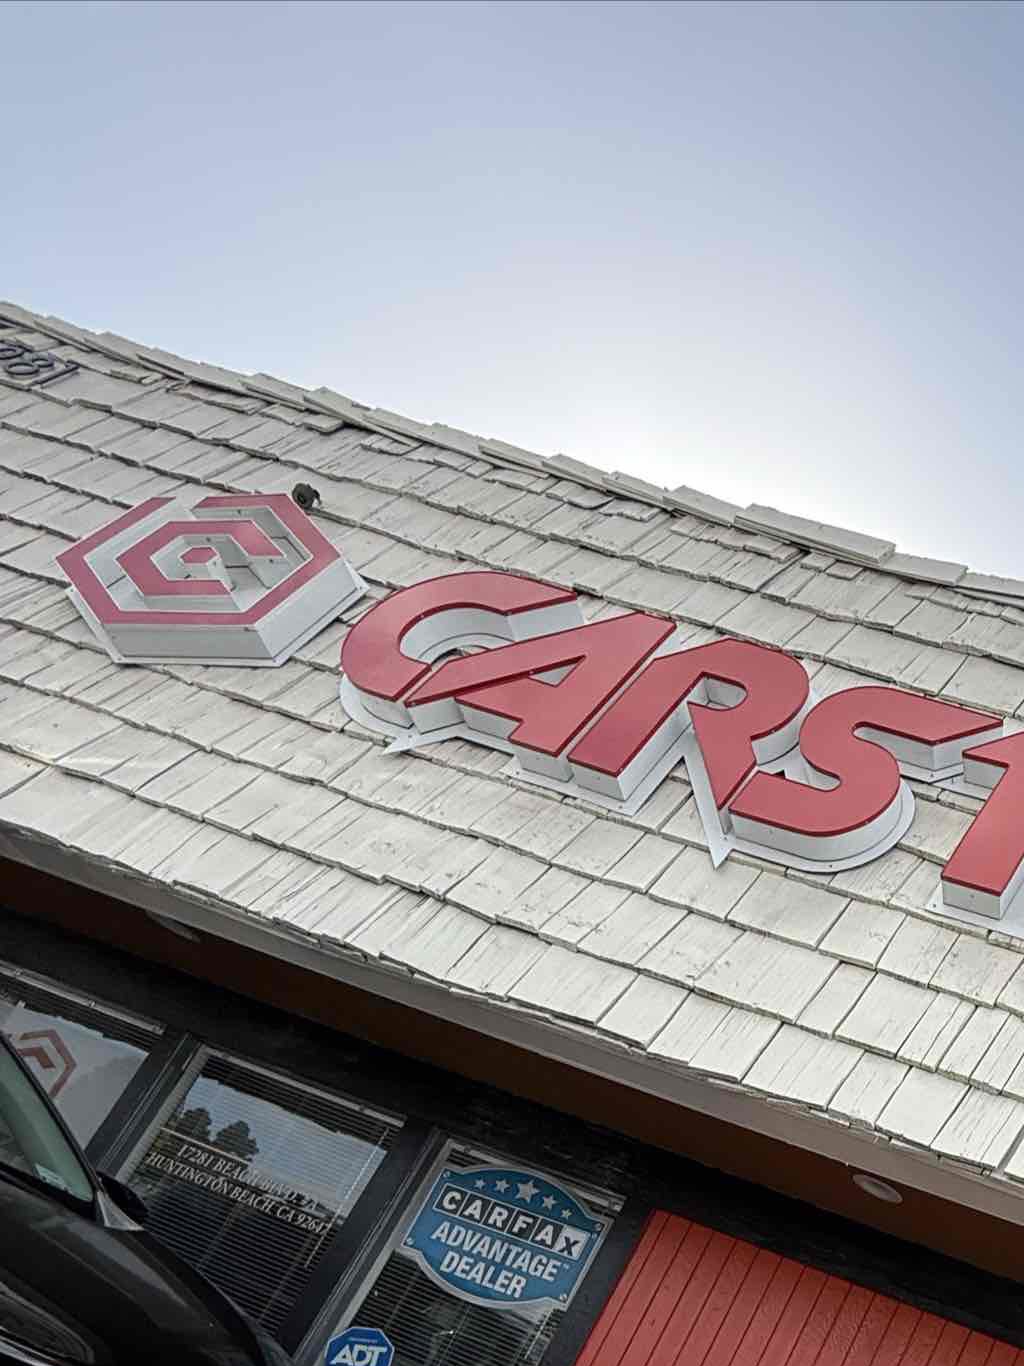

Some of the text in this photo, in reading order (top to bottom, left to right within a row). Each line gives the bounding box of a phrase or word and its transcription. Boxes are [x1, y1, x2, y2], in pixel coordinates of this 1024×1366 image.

[144, 1152, 231, 1194] HUNTINGTON
[276, 1204, 295, 1223] CA
[176, 1144, 214, 1168] 17281
[212, 1158, 261, 1186] BEACH
[430, 1220, 561, 1282] ADVANTAGE
[441, 1190, 581, 1258] CARFAX
[439, 1250, 527, 1299] DEALER
